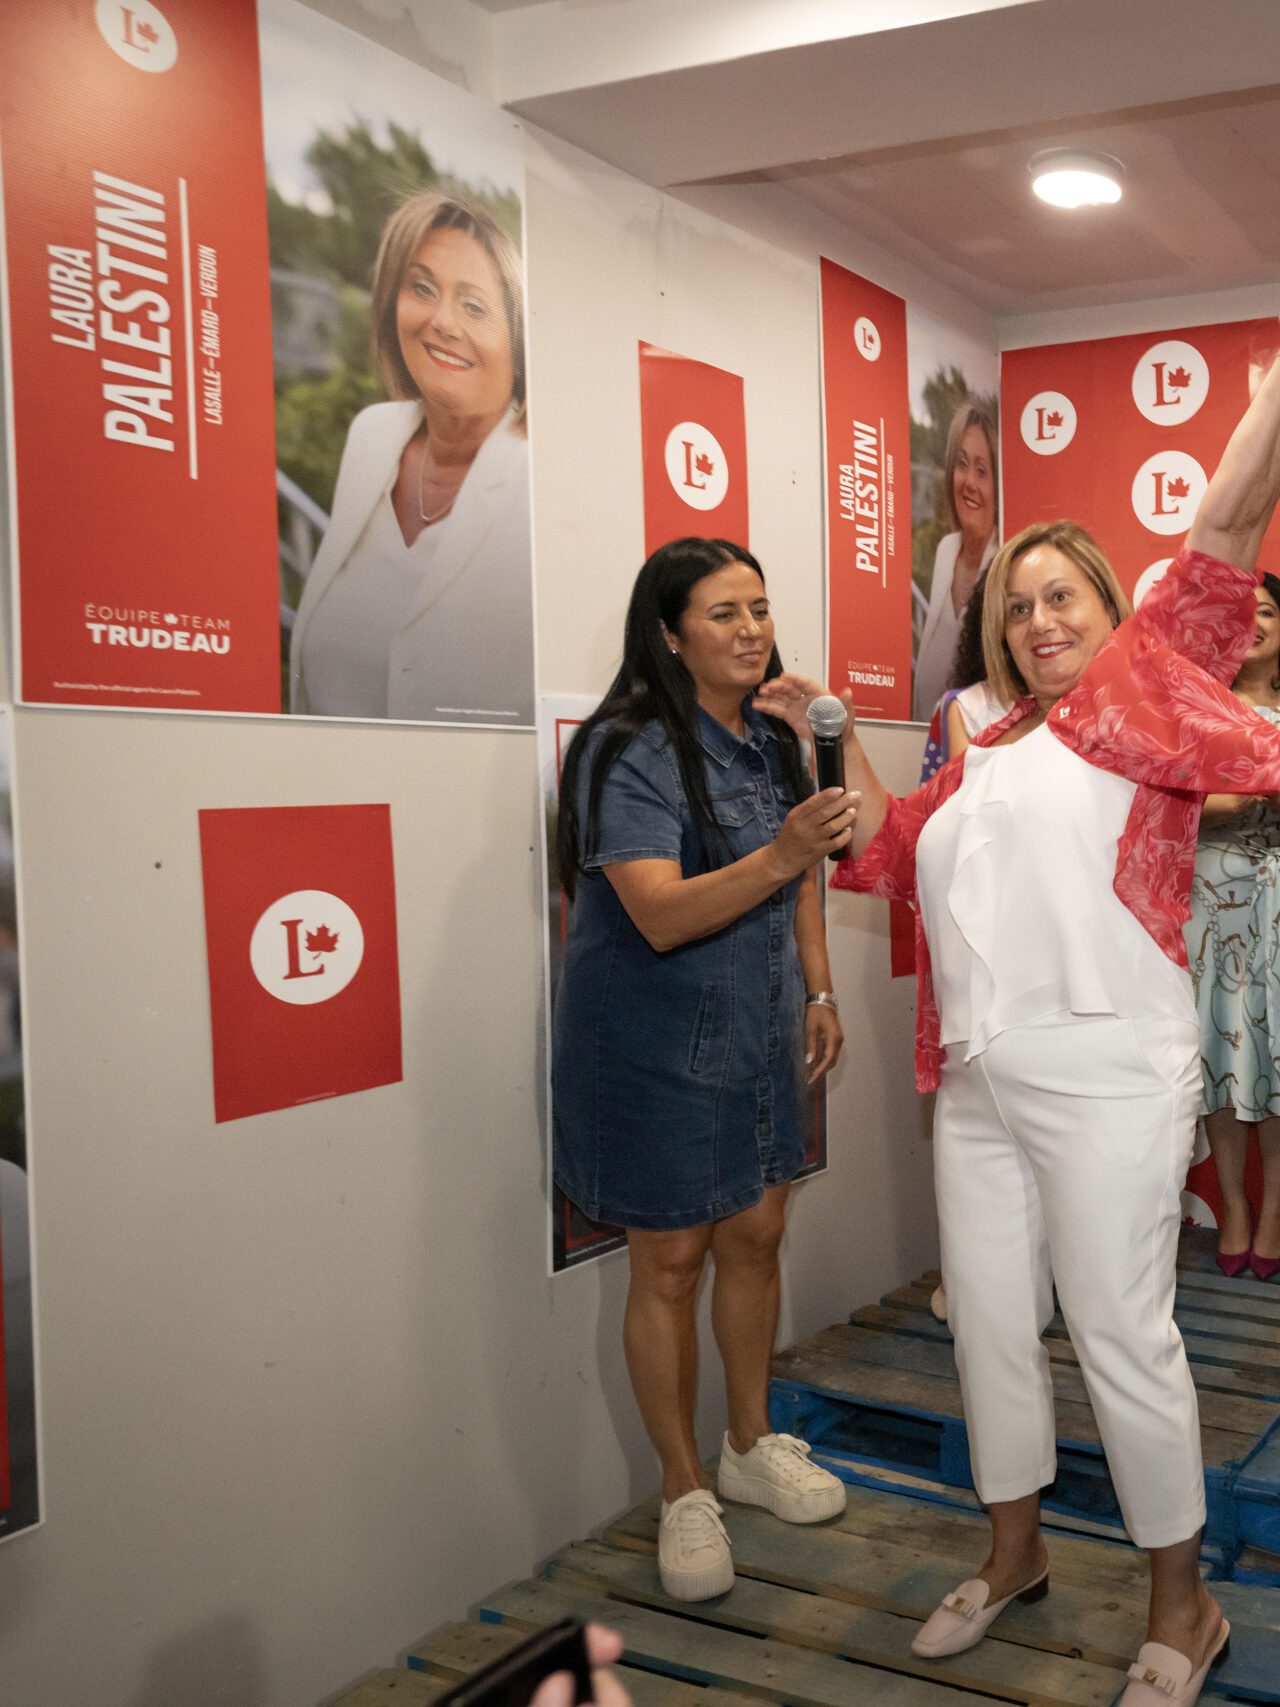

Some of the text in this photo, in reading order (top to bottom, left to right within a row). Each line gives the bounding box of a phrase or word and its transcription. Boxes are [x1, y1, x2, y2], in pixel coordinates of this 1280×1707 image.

[46, 244, 96, 351] LAURA
[92, 169, 175, 452] PALESTINI
[1151, 362, 1181, 407] L
[1035, 407, 1056, 441] L
[681, 440, 706, 490] L
[838, 463, 856, 521] LAURA
[852, 419, 879, 574] PALESTINI
[1151, 472, 1179, 516] L
[84, 602, 231, 631] ÉQUIPE TEAM
[85, 621, 231, 655] TRUDEAU
[847, 670, 895, 687] TRUDEAU
[280, 918, 325, 980] L
